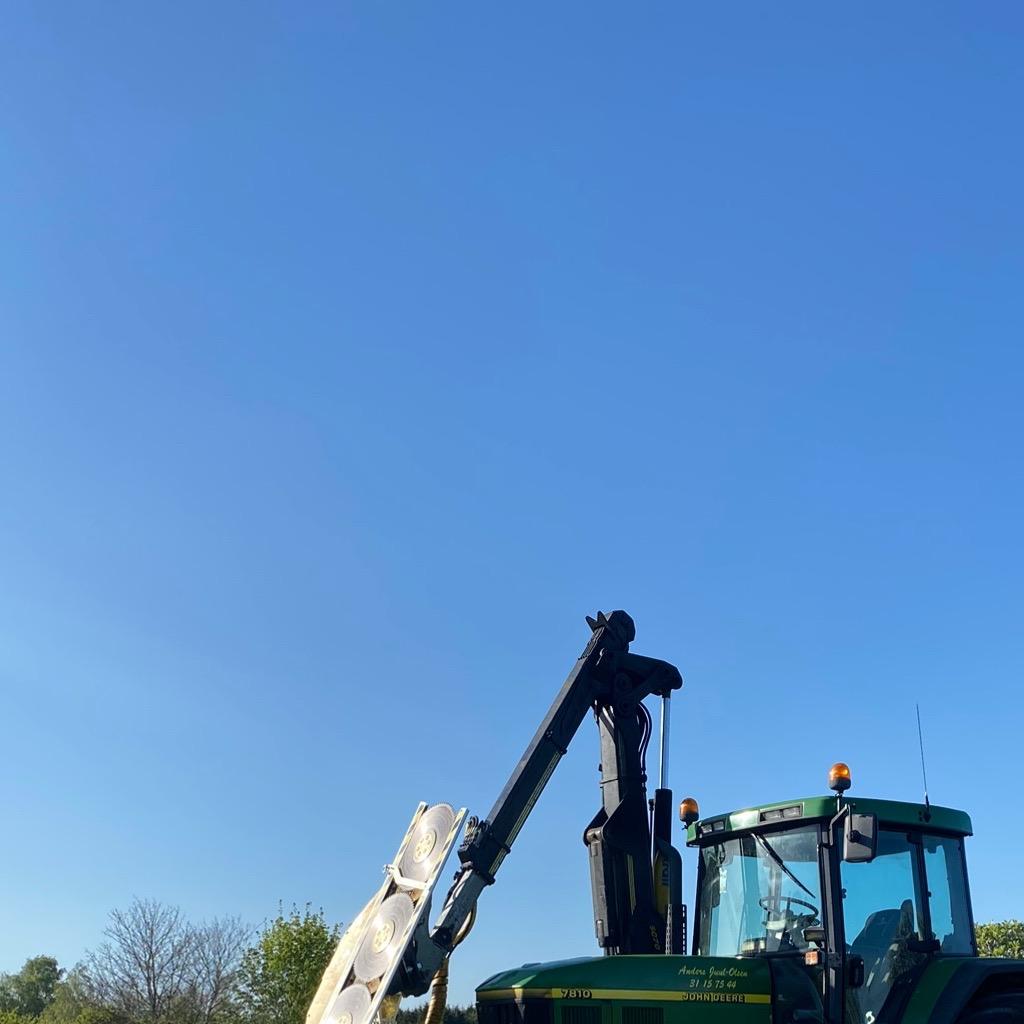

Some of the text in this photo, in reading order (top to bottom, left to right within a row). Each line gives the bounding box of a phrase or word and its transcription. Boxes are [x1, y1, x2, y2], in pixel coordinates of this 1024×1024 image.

[678, 965, 706, 976] Anders
[689, 979, 737, 990] 31 15 75 44
[562, 988, 592, 999] 7810
[682, 992, 745, 1004] JOHN DEERE
